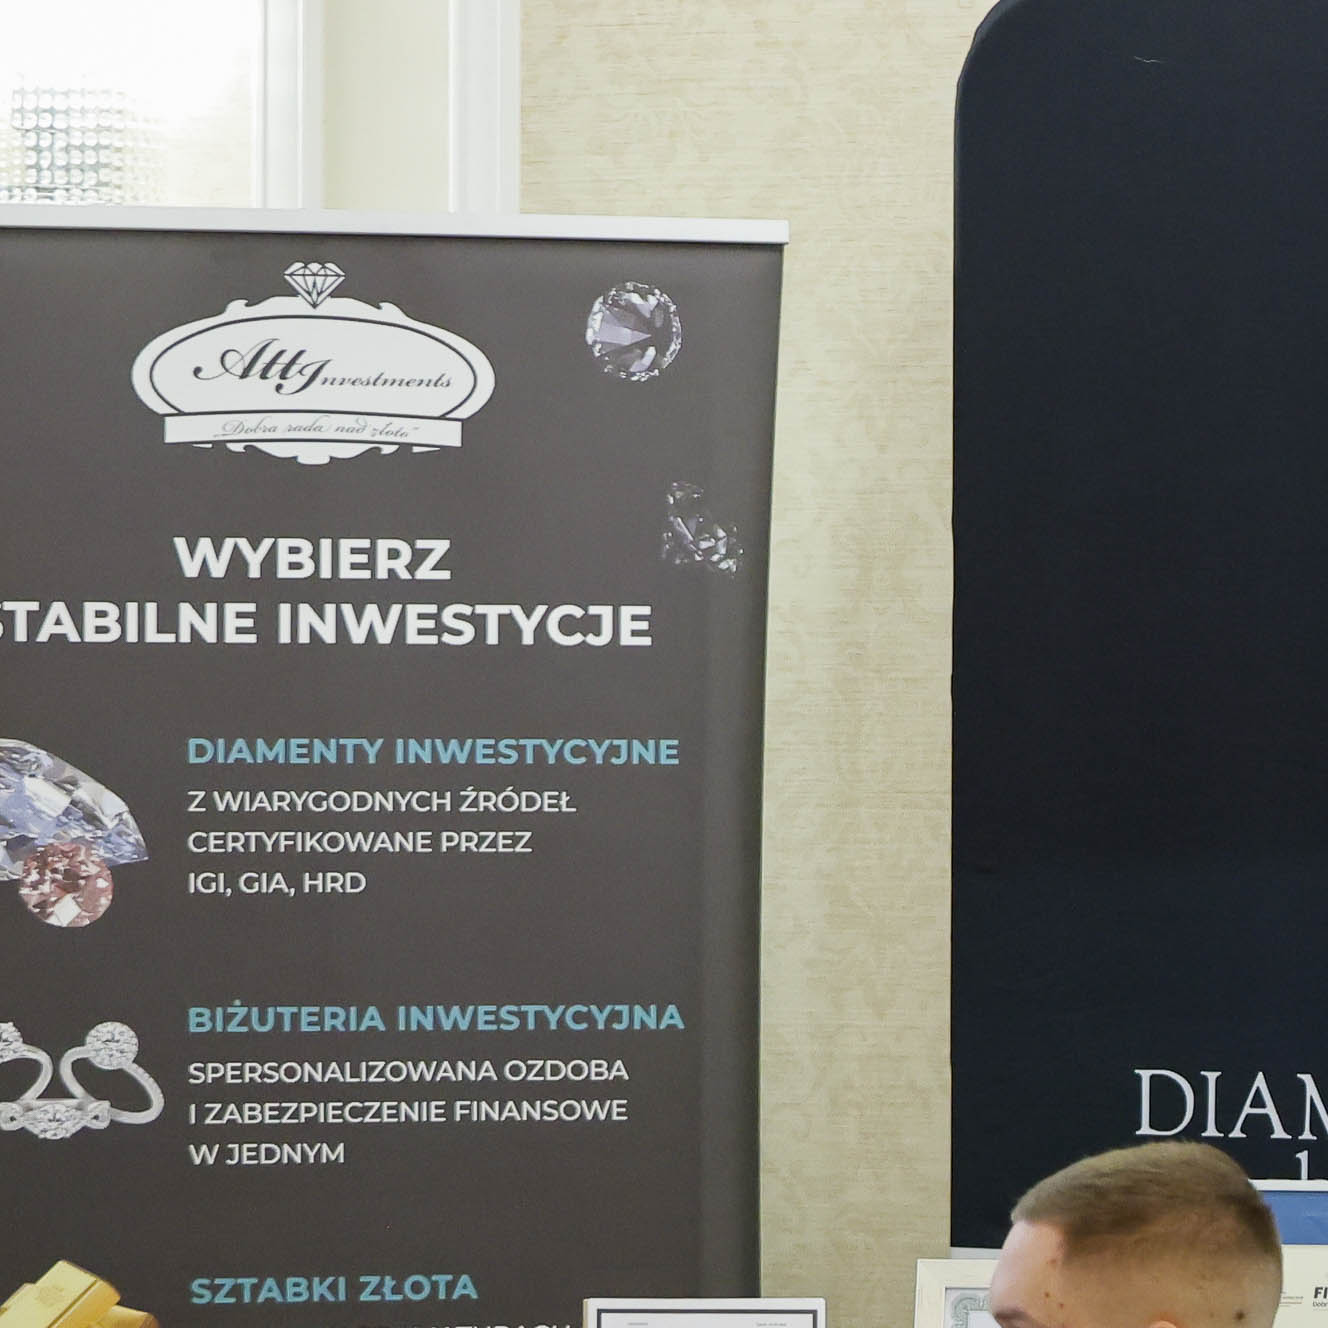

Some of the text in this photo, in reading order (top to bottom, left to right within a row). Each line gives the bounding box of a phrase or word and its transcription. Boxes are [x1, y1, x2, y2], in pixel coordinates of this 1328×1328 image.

[173, 536, 452, 581] WYBIERZ
[277, 603, 653, 648] INWESTYCJE
[188, 738, 680, 766] DIAMENTY INWESTYCYJNE
[188, 786, 577, 813] Z WIARYGODNYCH ŹRÓDEŁ
[188, 830, 533, 855] CERTYFIKOWANE PRZEZ
[188, 871, 367, 898] IGI, GIA, HRD
[188, 999, 685, 1034] BIŻUTERIA INWESTYCYJNA
[188, 1058, 629, 1085] SPERSONALIZOWANA OZDOBA
[188, 1098, 628, 1126] I ZABEZPIECZENIE FINANSOWE
[188, 1141, 345, 1166] W JEDNYM
[190, 1272, 479, 1304] SZTABKI ZŁOTA
